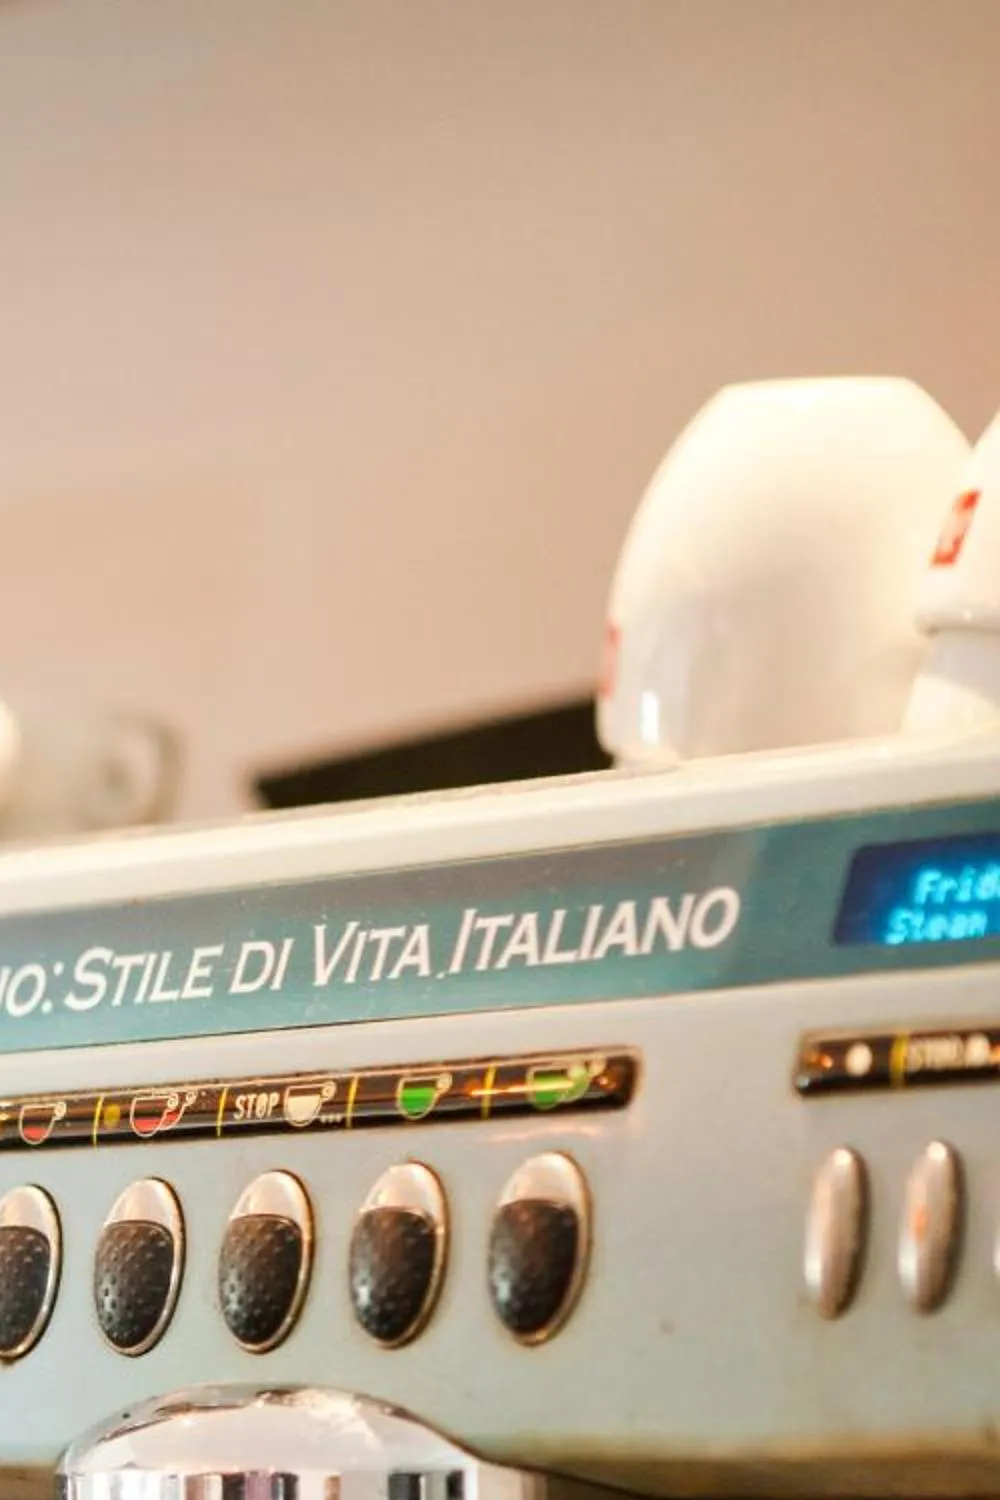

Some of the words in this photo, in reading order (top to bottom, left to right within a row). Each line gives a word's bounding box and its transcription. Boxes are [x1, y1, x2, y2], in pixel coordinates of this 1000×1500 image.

[63, 946, 225, 1011] STILE
[228, 938, 295, 994] DI
[448, 886, 741, 976] ITALIANO
[233, 1091, 281, 1121] STOP
